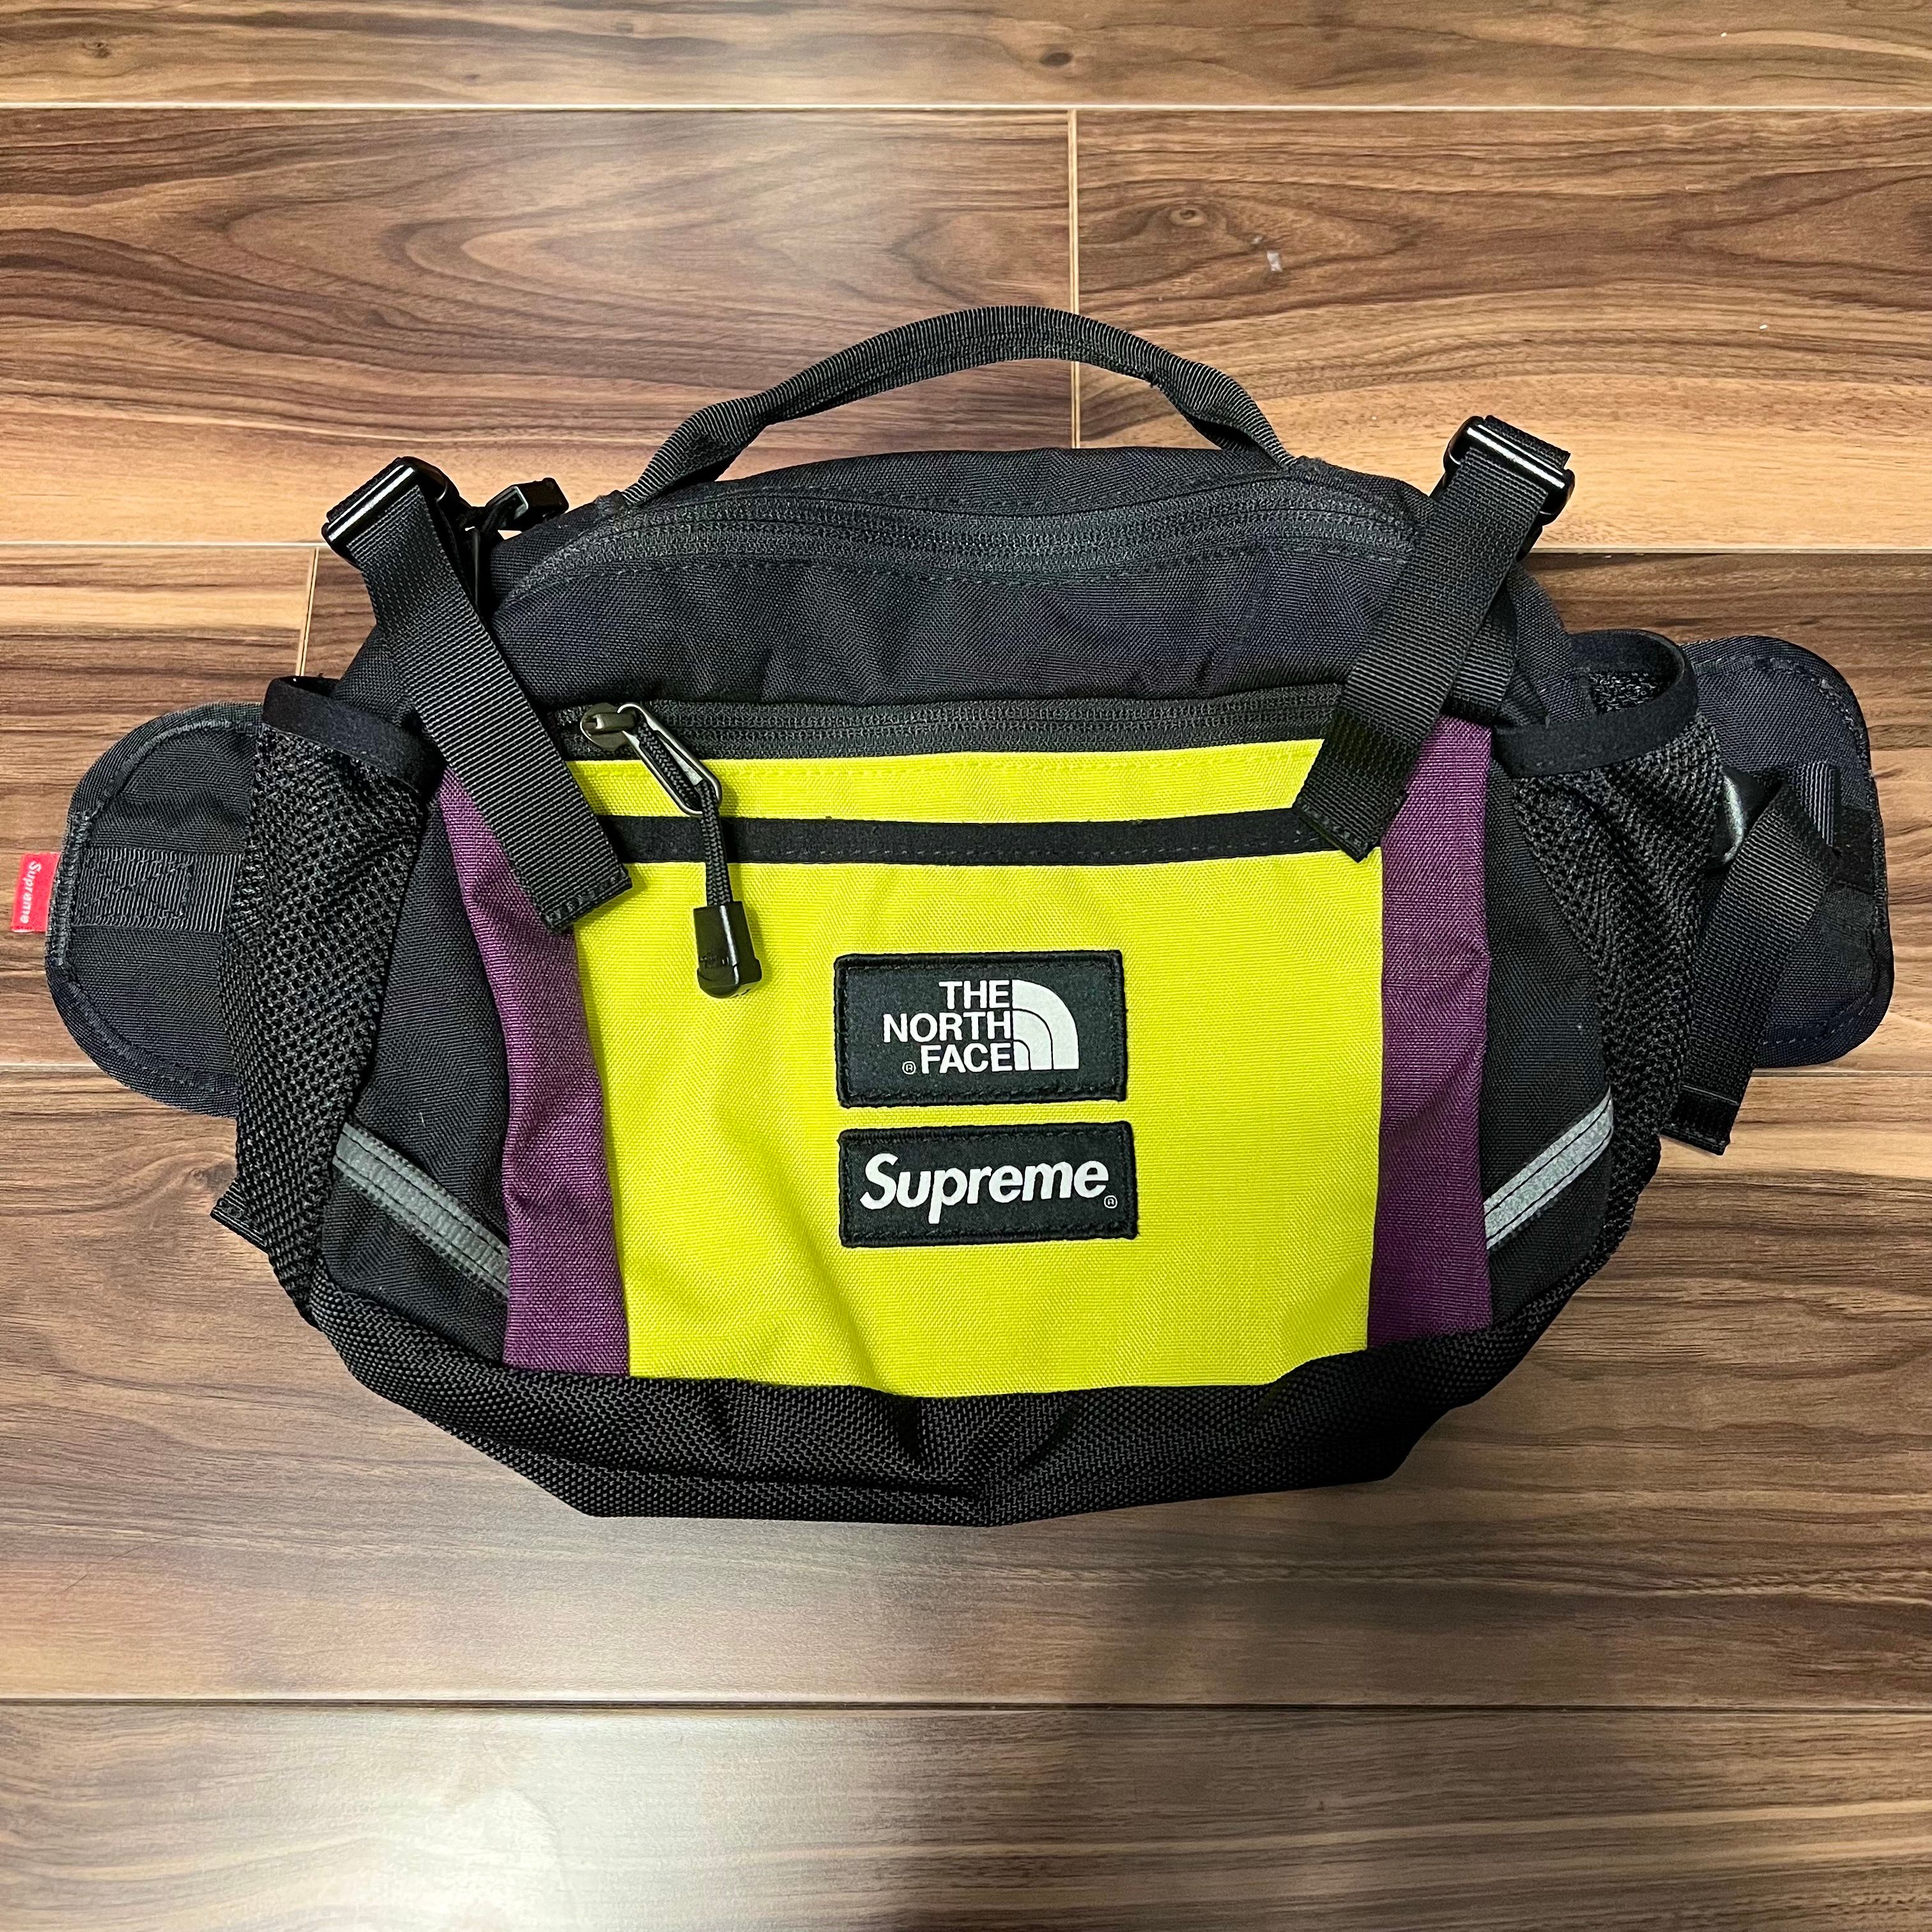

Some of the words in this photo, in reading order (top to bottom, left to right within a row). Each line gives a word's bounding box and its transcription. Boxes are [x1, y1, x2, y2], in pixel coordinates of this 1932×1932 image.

[20, 861, 42, 924] Supreme
[938, 979, 1011, 1009] THE
[883, 1010, 1012, 1043] NORTH
[920, 1042, 1013, 1074] FACE
[859, 1153, 1109, 1224] Supreme
